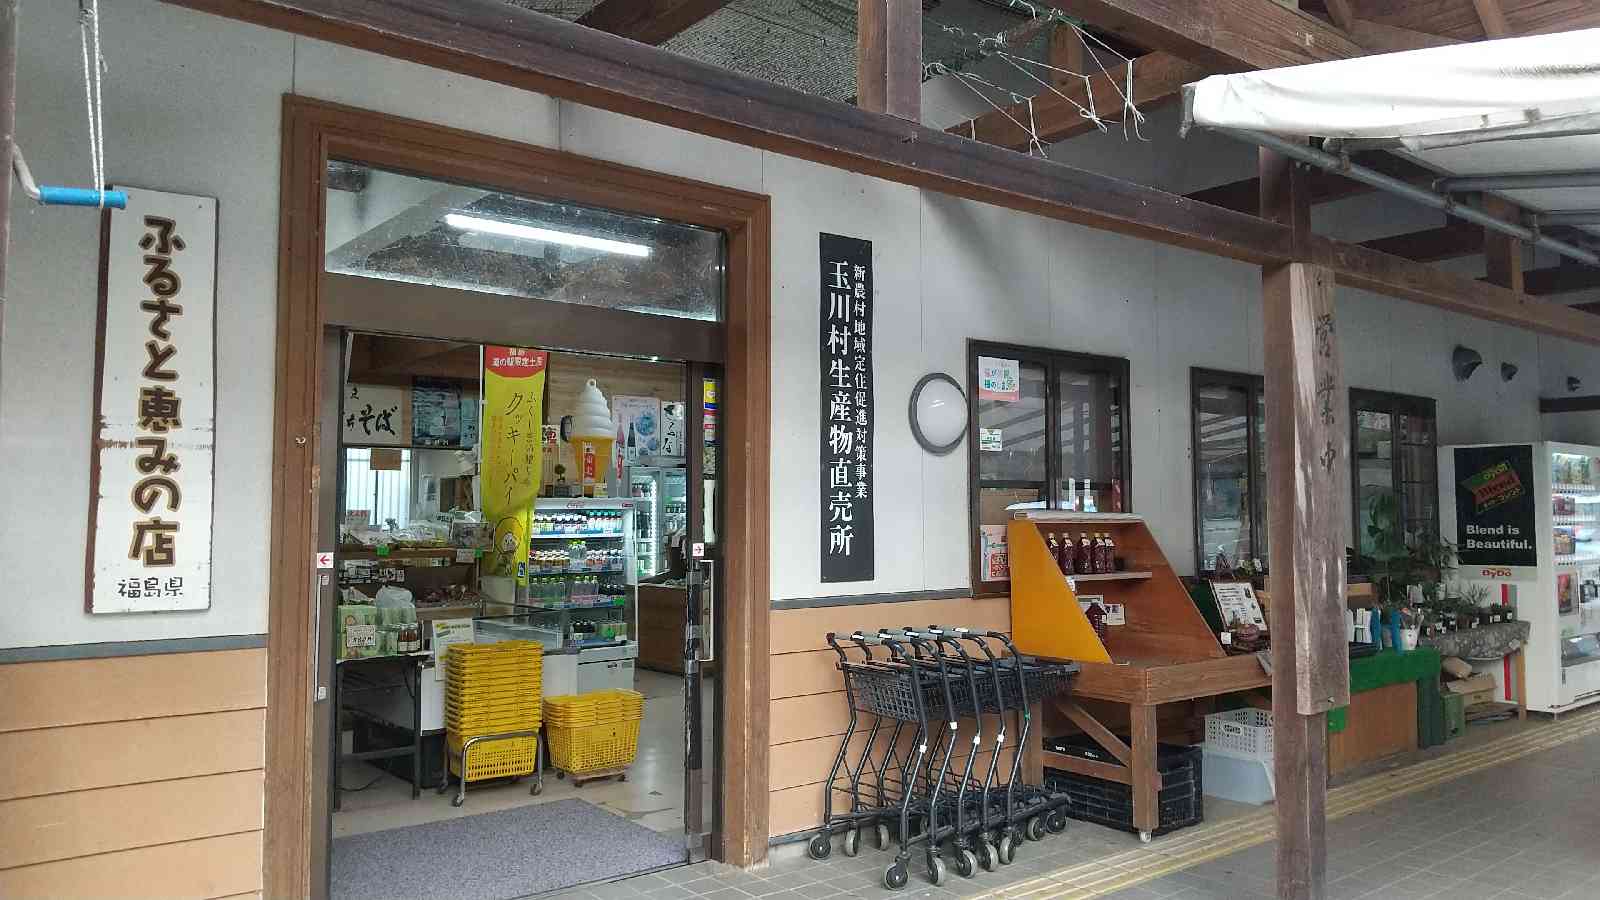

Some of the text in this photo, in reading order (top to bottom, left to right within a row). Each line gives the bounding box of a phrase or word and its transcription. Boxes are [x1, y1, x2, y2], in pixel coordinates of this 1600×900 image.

[127, 213, 186, 569] ふるさと恵みの店
[827, 259, 854, 557] 玉川村生産物直売所
[853, 263, 868, 499] 新農村地域定住促進対策事業
[503, 391, 523, 505] クッキーパイ
[117, 575, 184, 599] 福島県
[1466, 525, 1520, 535] Blend is
[1466, 539, 1533, 550] Beautiful.
